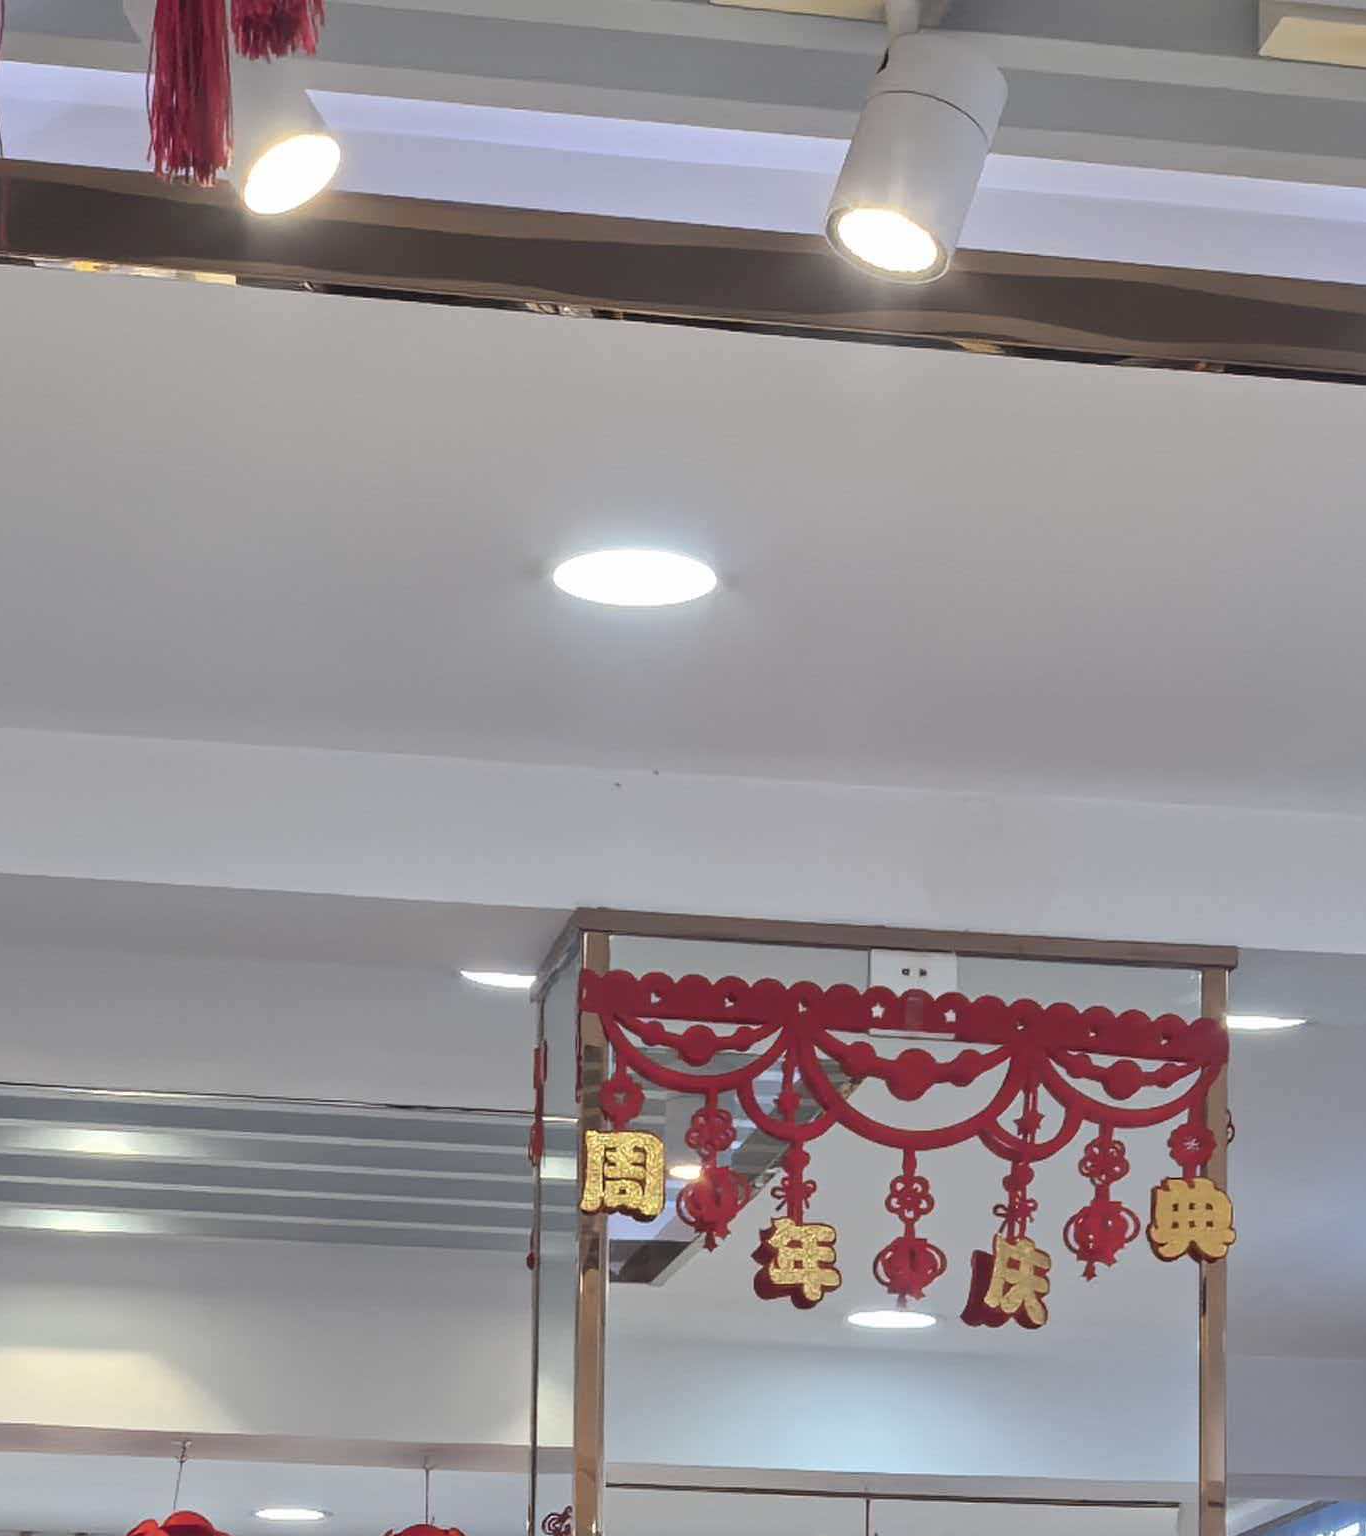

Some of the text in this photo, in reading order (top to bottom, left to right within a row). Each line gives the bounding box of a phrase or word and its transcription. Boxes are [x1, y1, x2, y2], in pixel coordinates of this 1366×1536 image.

[581, 1129, 666, 1221] 周
[769, 1217, 843, 1304] 年
[1149, 1177, 1235, 1262] 典
